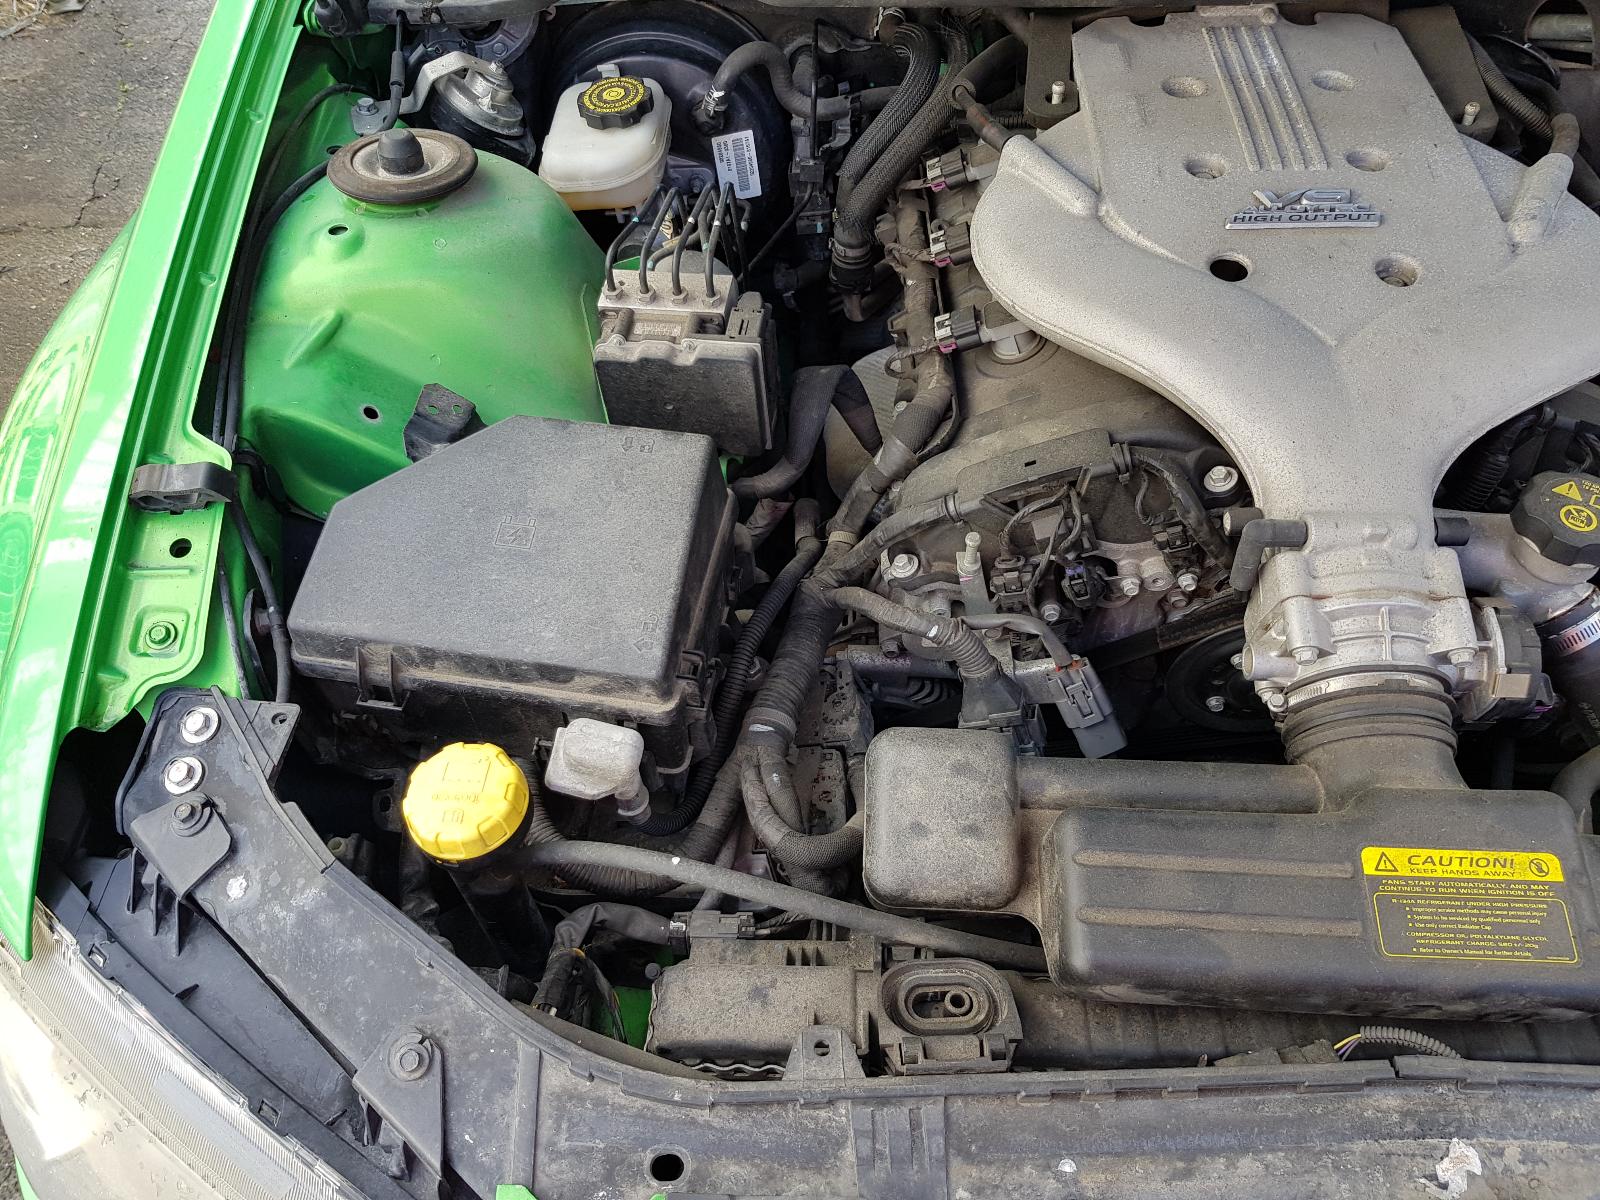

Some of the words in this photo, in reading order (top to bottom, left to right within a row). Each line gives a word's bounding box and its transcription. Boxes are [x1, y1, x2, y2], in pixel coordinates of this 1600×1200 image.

[1252, 188, 1351, 208] V6
[1233, 214, 1283, 223] HIGH
[1288, 213, 1376, 222] OUTPUT
[1407, 854, 1515, 869] CAUTION!
[1442, 868, 1480, 876] HANDS
